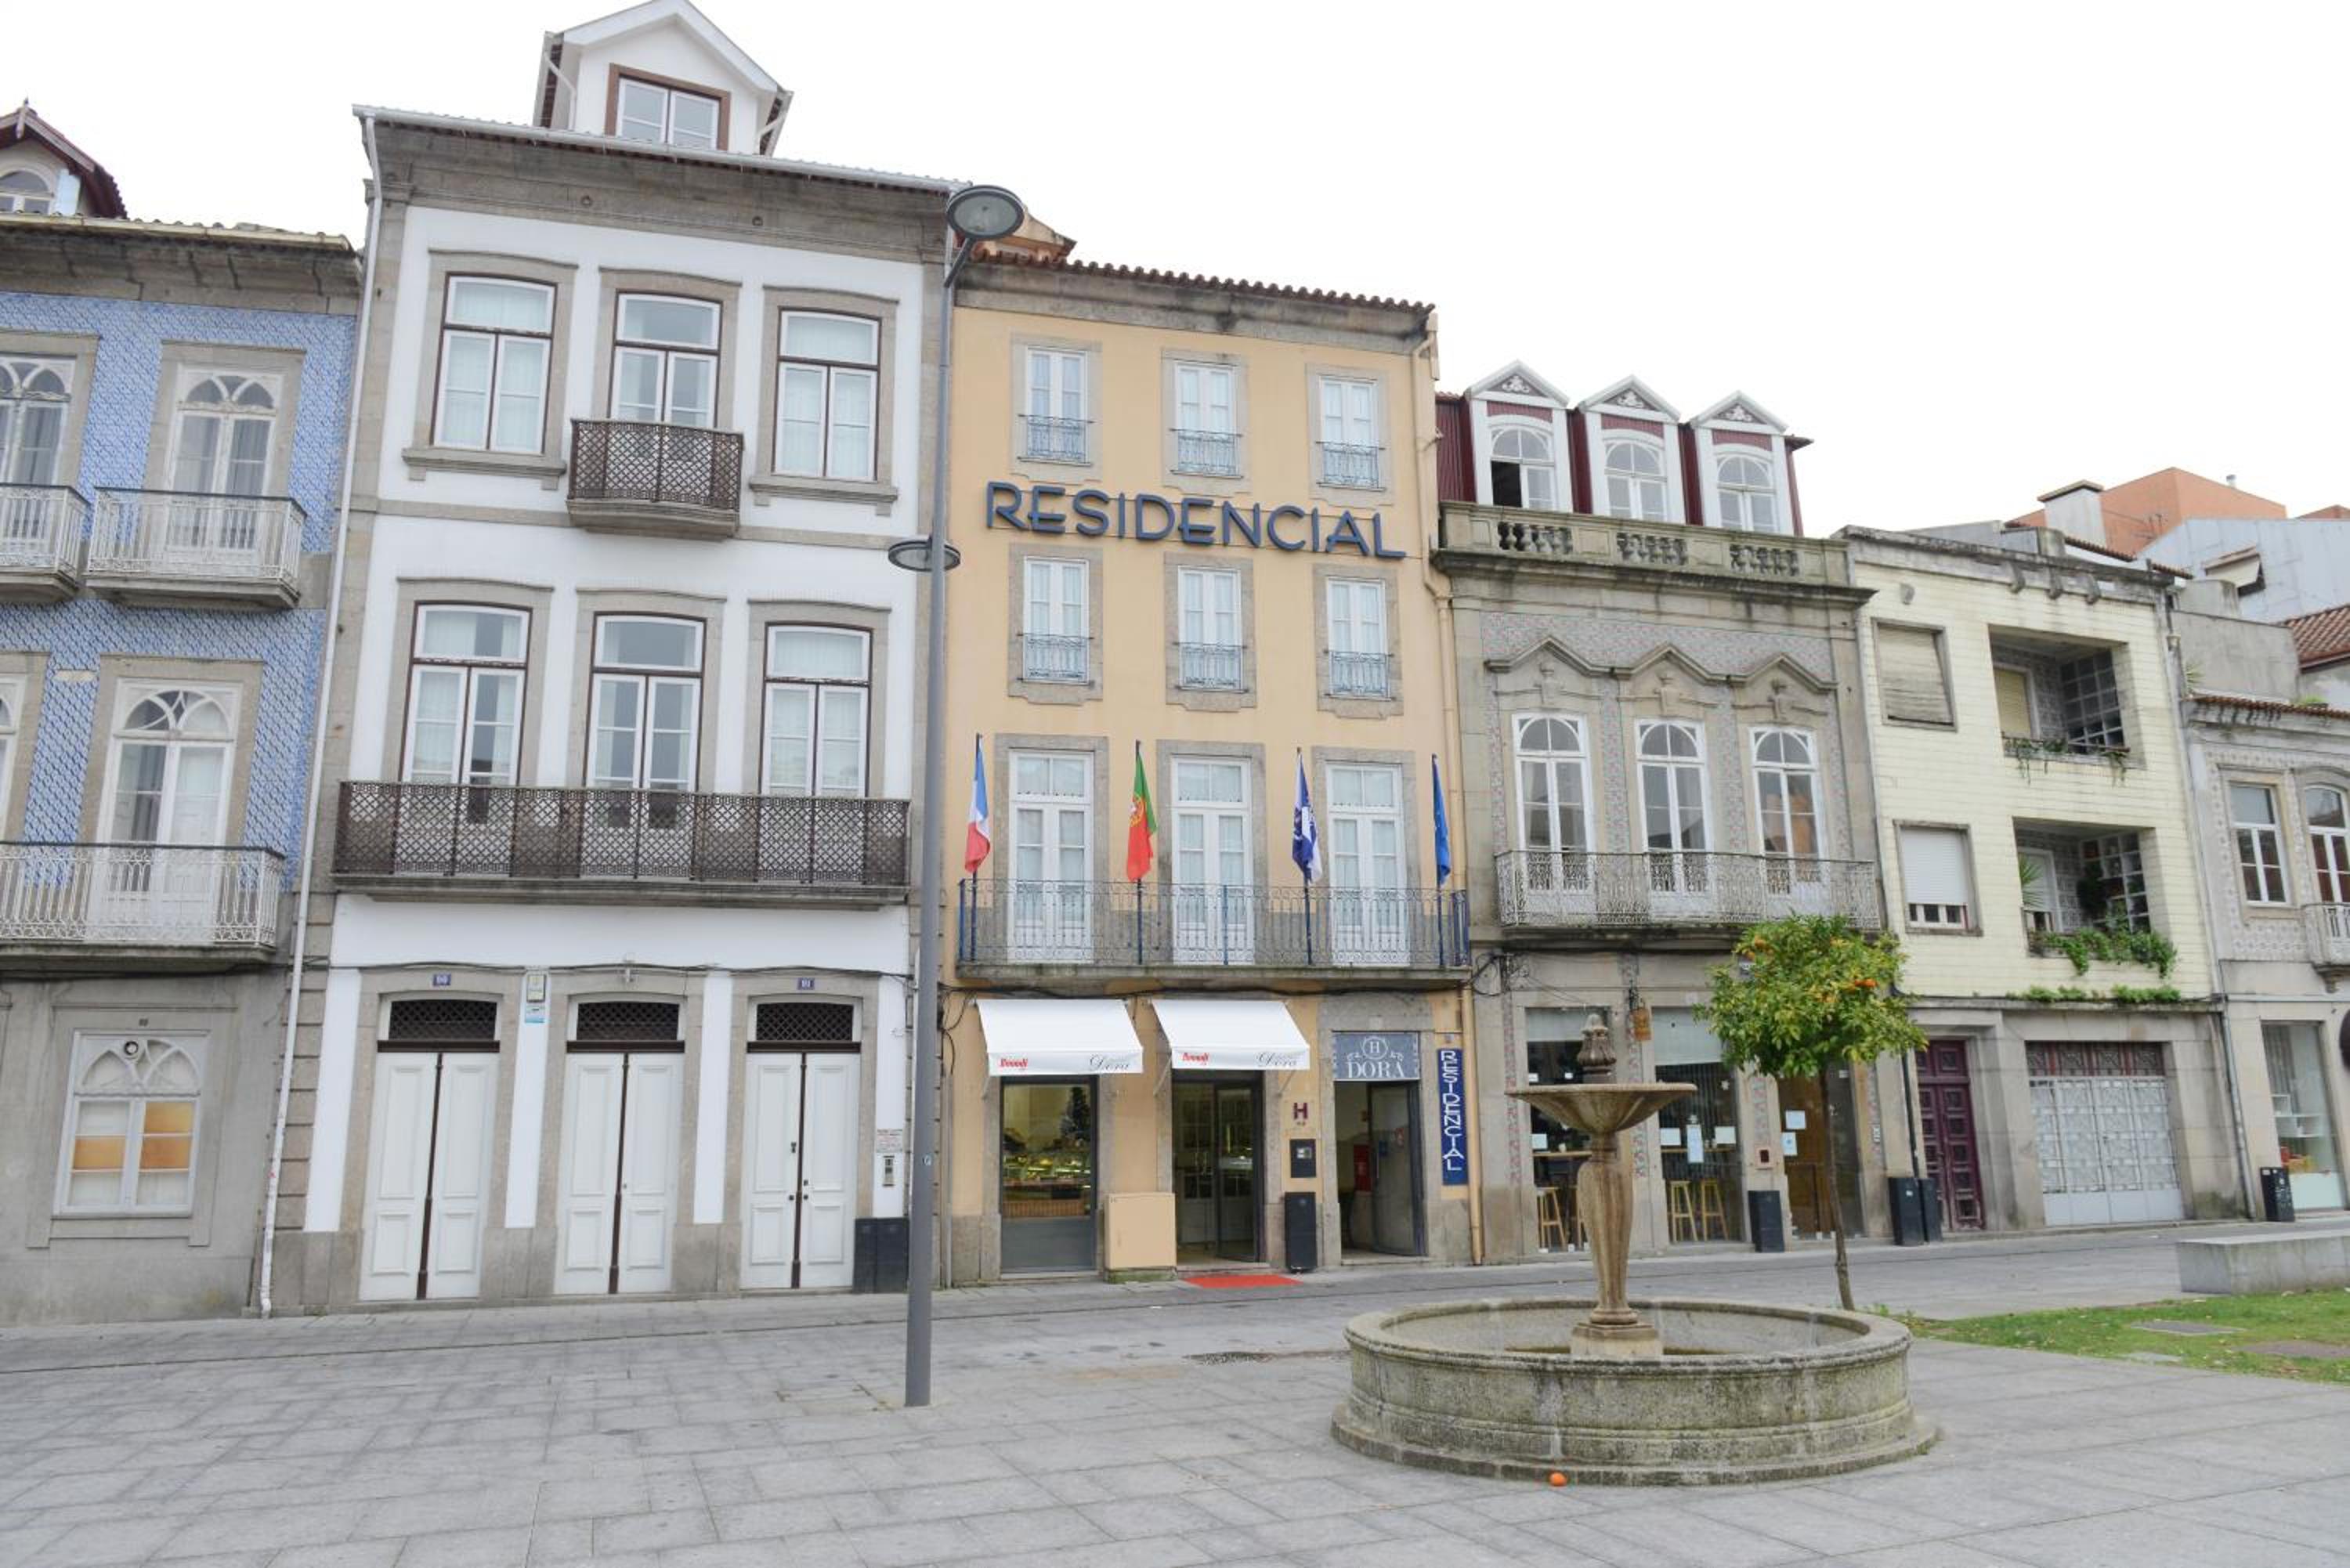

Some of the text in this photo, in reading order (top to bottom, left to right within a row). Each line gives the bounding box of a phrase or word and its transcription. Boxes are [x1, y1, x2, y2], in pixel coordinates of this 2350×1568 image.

[985, 481, 1406, 559] RESIDENCIAL
[1369, 1041, 1380, 1053] H
[1089, 1053, 1130, 1071] Dora
[1346, 1061, 1405, 1078] DORA
[1293, 1102, 1308, 1120] H
[1441, 1050, 1465, 1171] RESIDENCIAL
